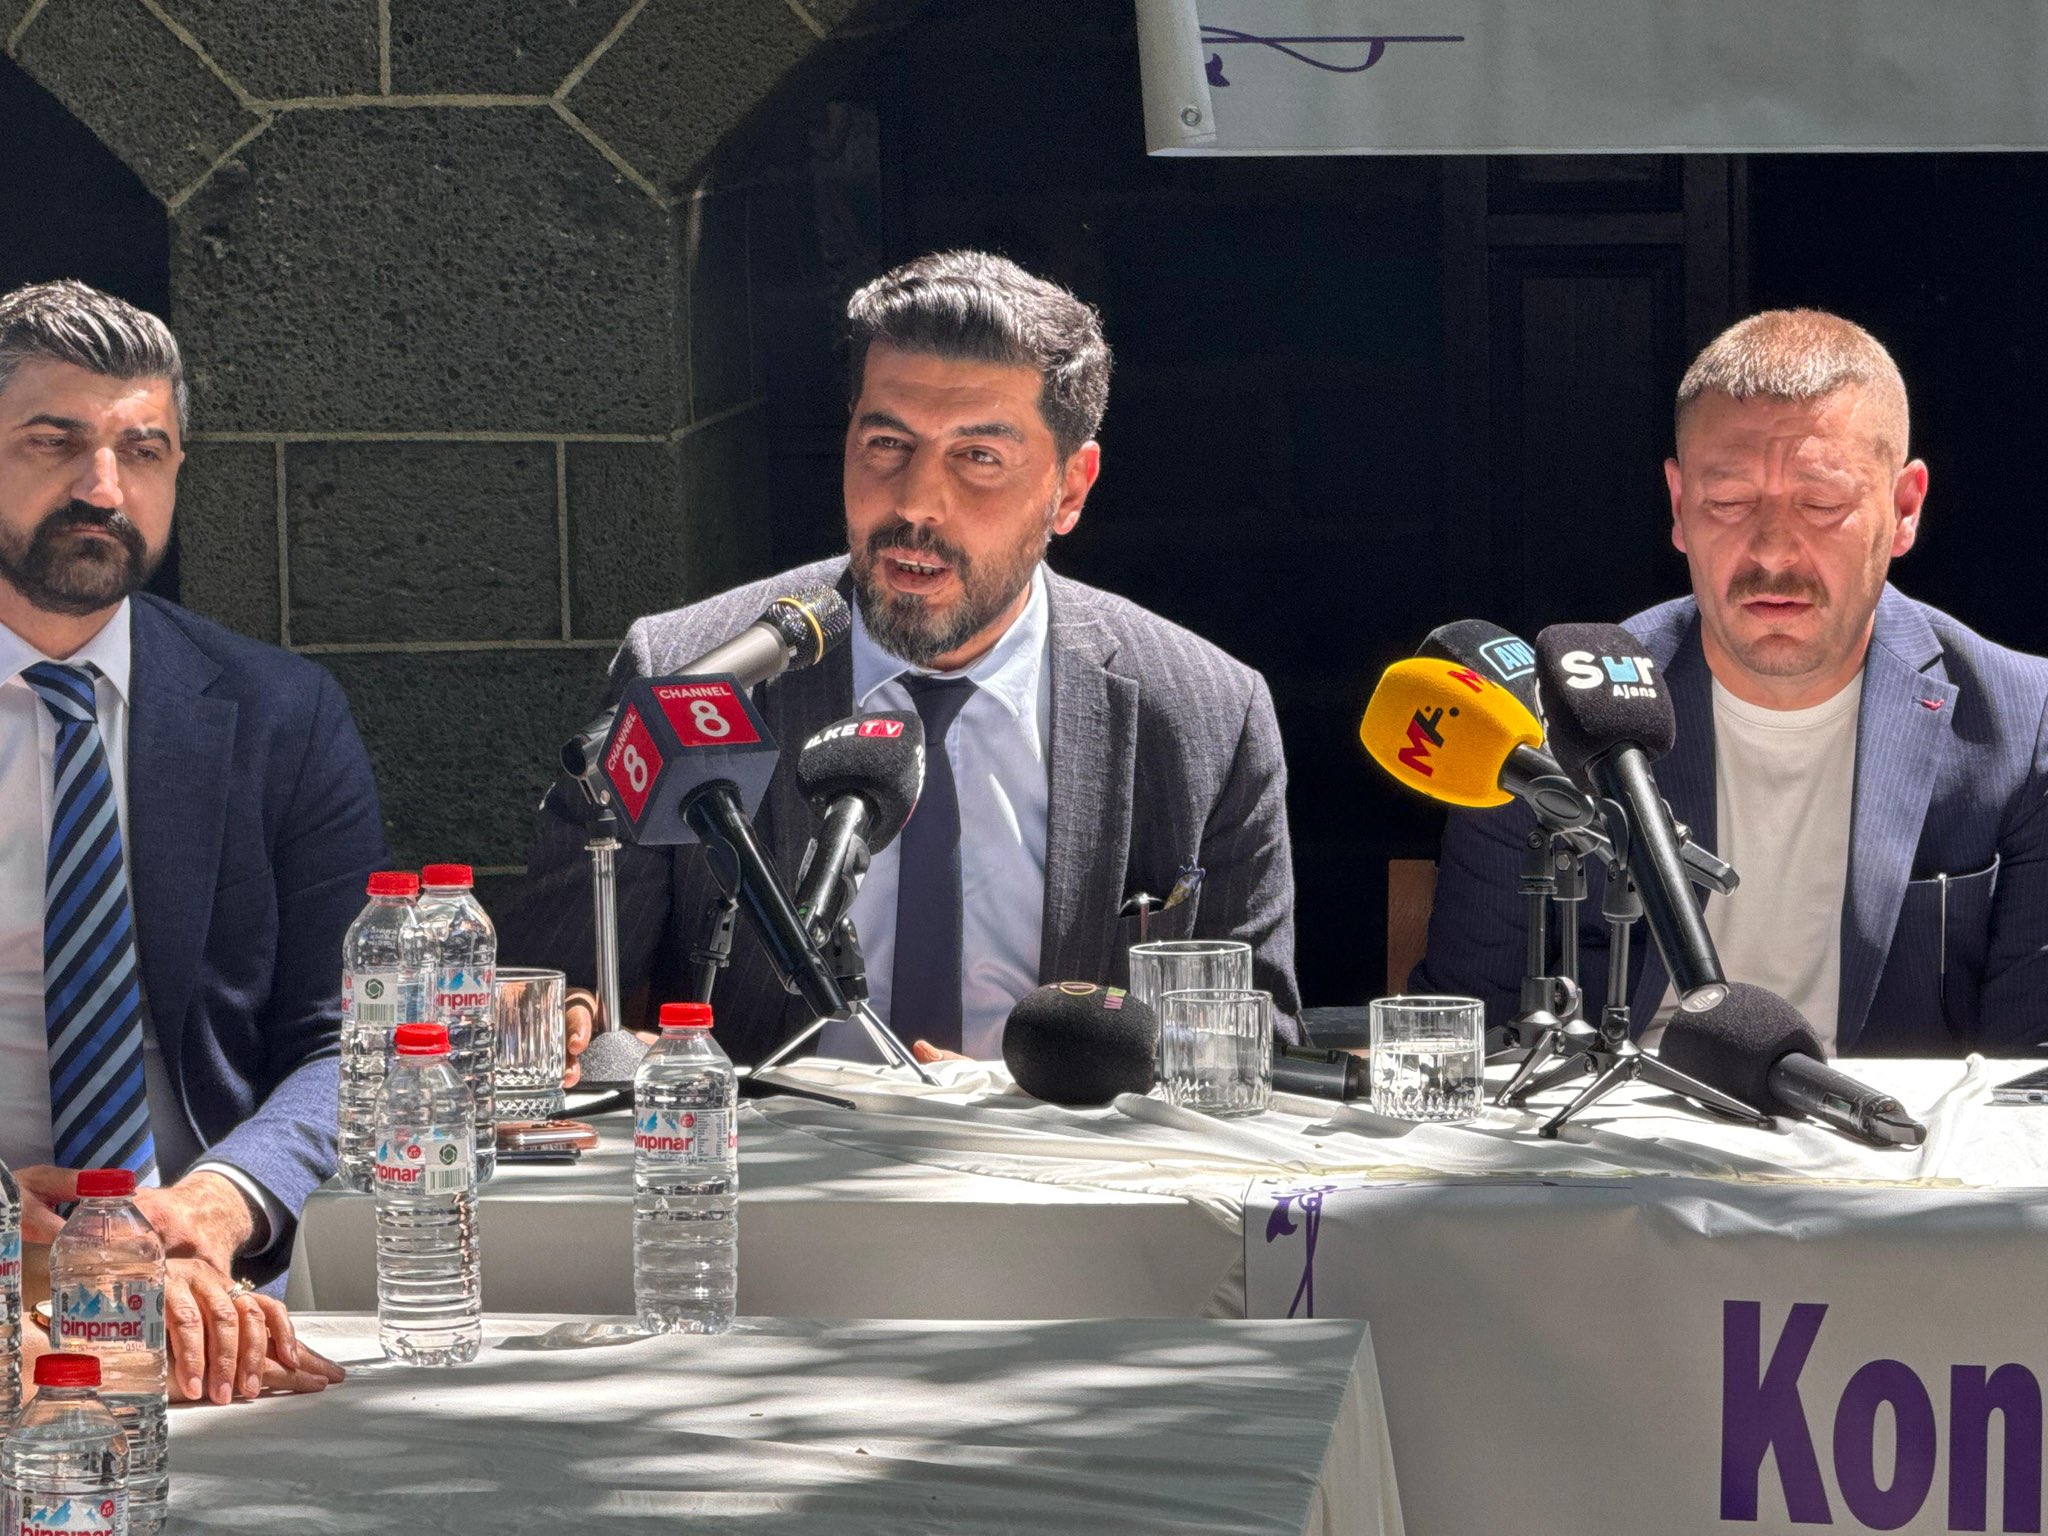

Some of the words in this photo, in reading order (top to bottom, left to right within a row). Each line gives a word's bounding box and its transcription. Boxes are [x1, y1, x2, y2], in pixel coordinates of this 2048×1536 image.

[659, 686, 731, 700] CHANNEL
[1613, 684, 1657, 699] Ajans
[689, 700, 731, 738] 8
[864, 722, 900, 735] TV
[607, 711, 637, 772] CHANNEL
[623, 744, 648, 793] 8
[1720, 1300, 2042, 1534] Kon
